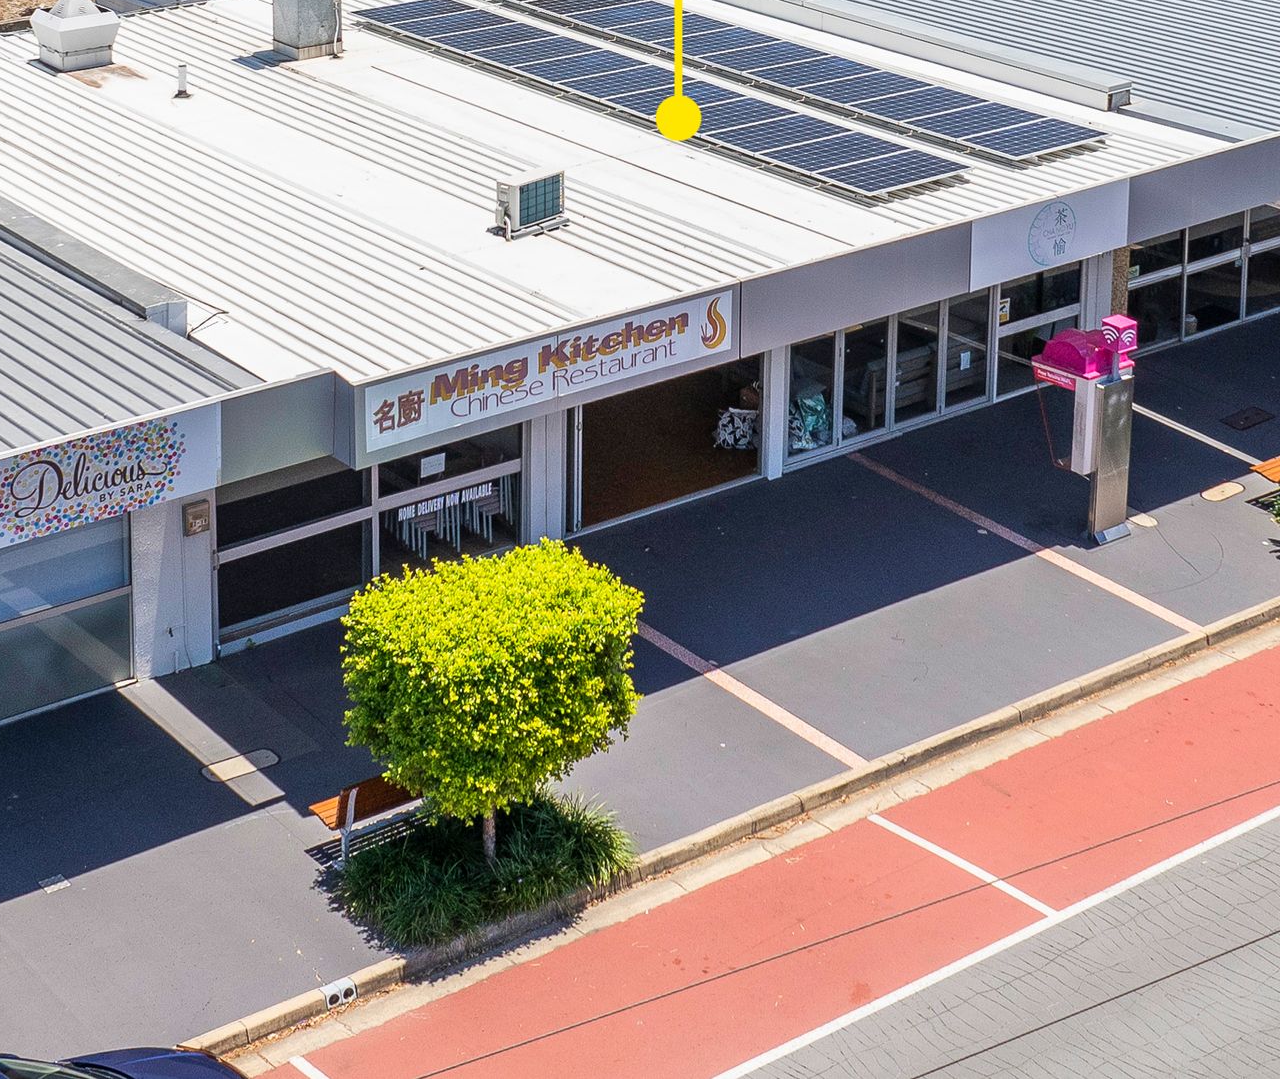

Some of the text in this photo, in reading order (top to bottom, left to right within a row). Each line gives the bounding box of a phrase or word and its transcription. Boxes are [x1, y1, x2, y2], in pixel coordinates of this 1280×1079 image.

[429, 310, 689, 405] Ming Kitchen
[450, 338, 677, 418] Chinese Restaurant
[9, 451, 168, 519] Delicious
[99, 480, 152, 503] BY SARA
[398, 482, 493, 522] HOME DELIVERY NOW AVAILABLE
